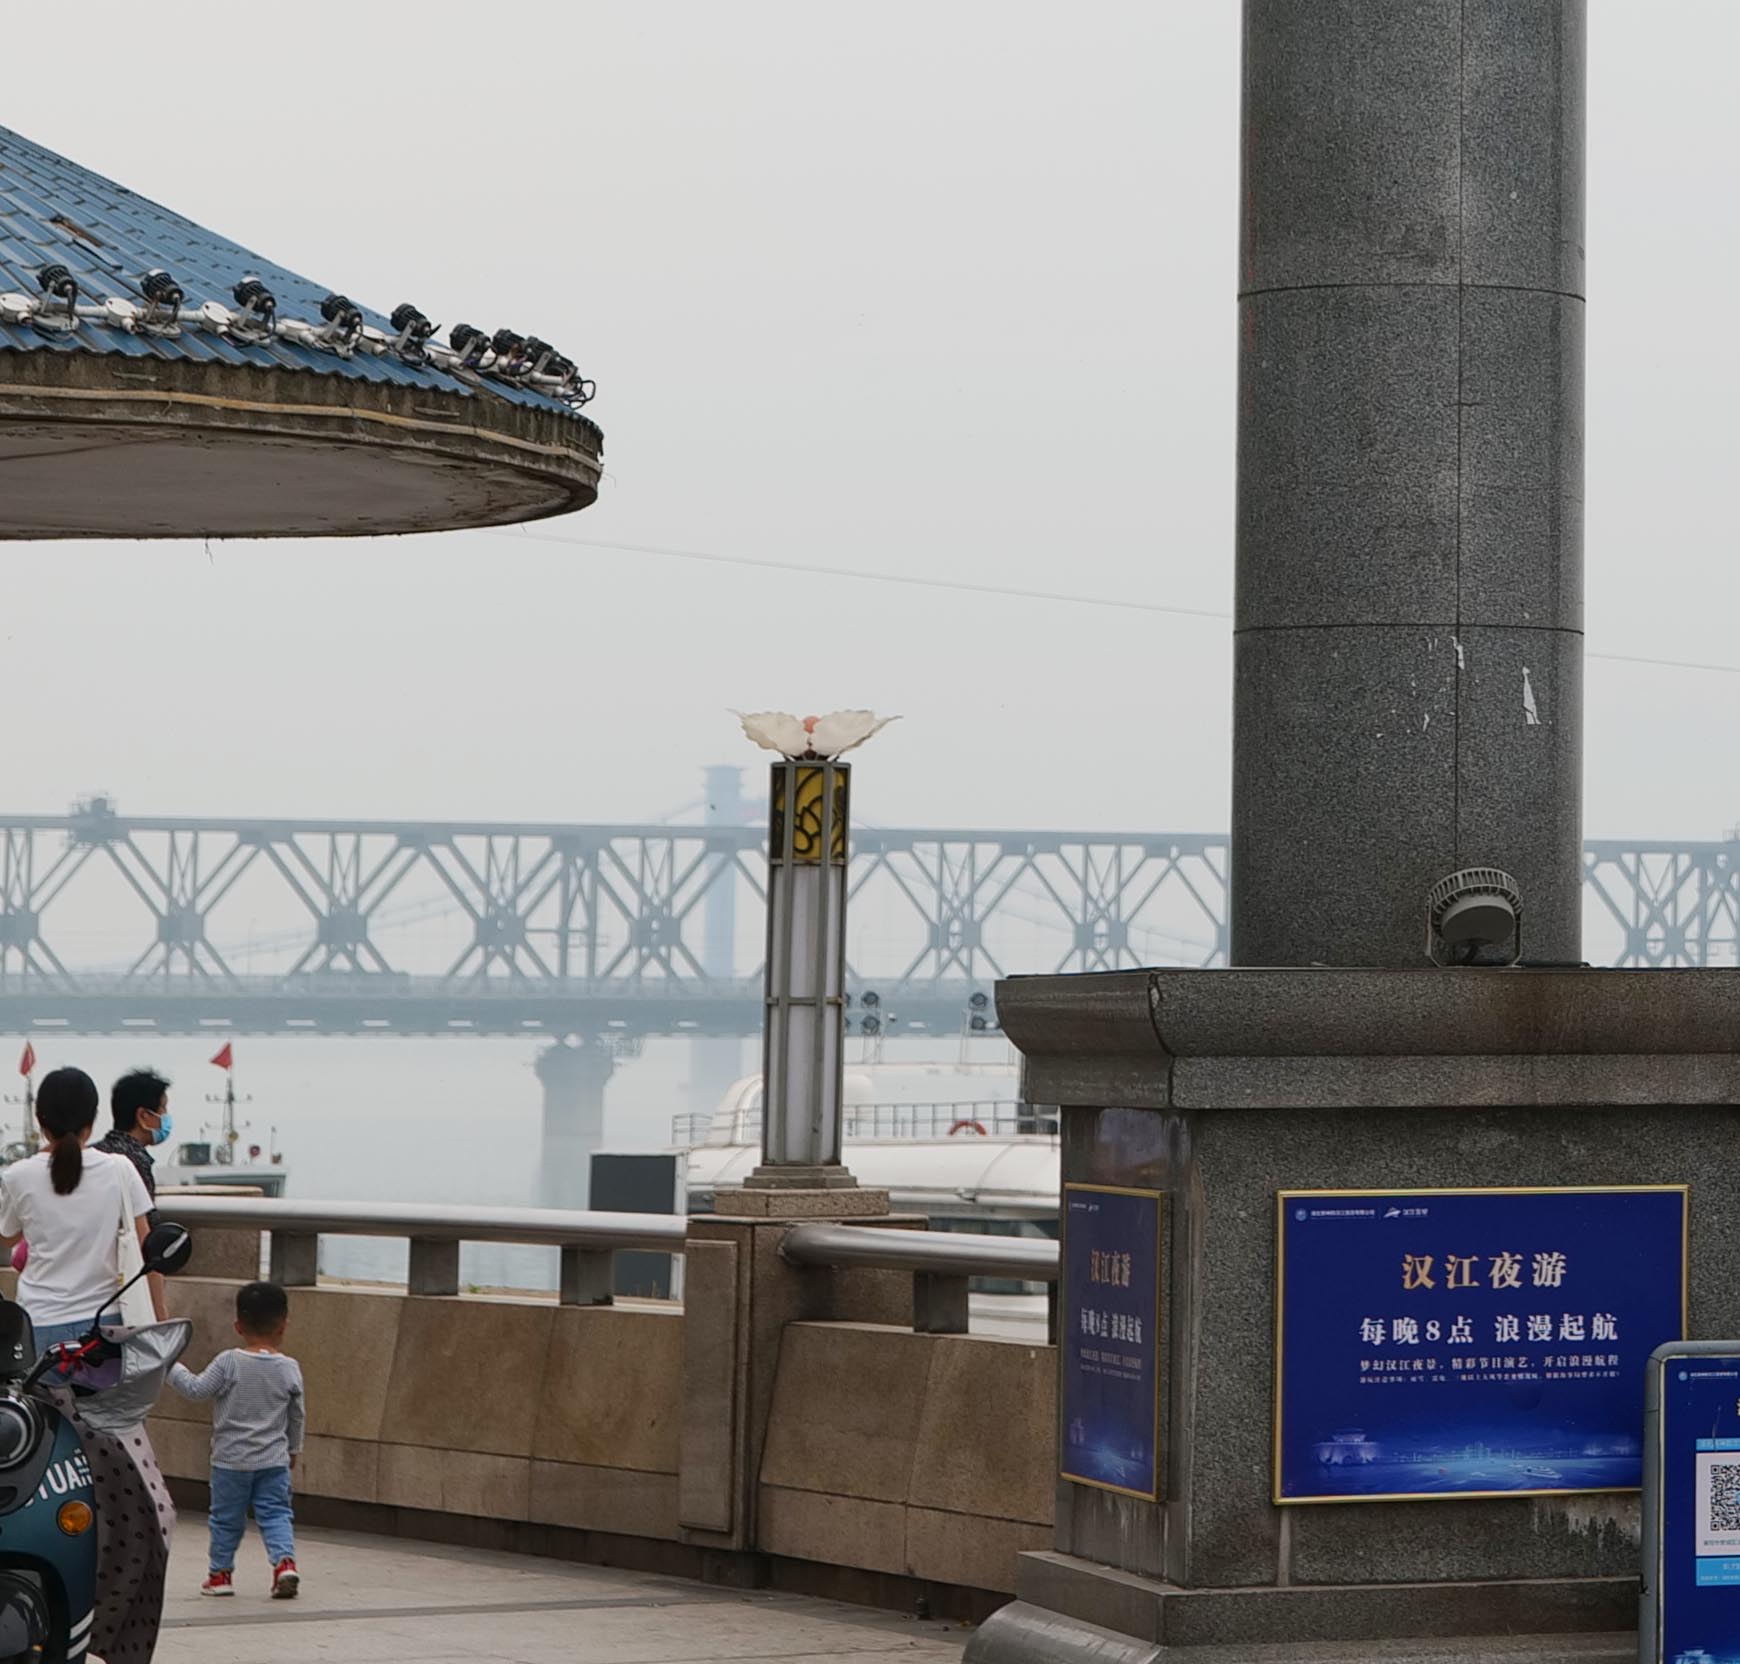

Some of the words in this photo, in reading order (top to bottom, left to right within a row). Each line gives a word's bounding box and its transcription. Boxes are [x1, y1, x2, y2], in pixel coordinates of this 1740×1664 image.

[1401, 1251, 1568, 1289] 汉江夜游
[1359, 1315, 1475, 1346] 每晚8点
[1494, 1313, 1619, 1342] 浪漫起航
